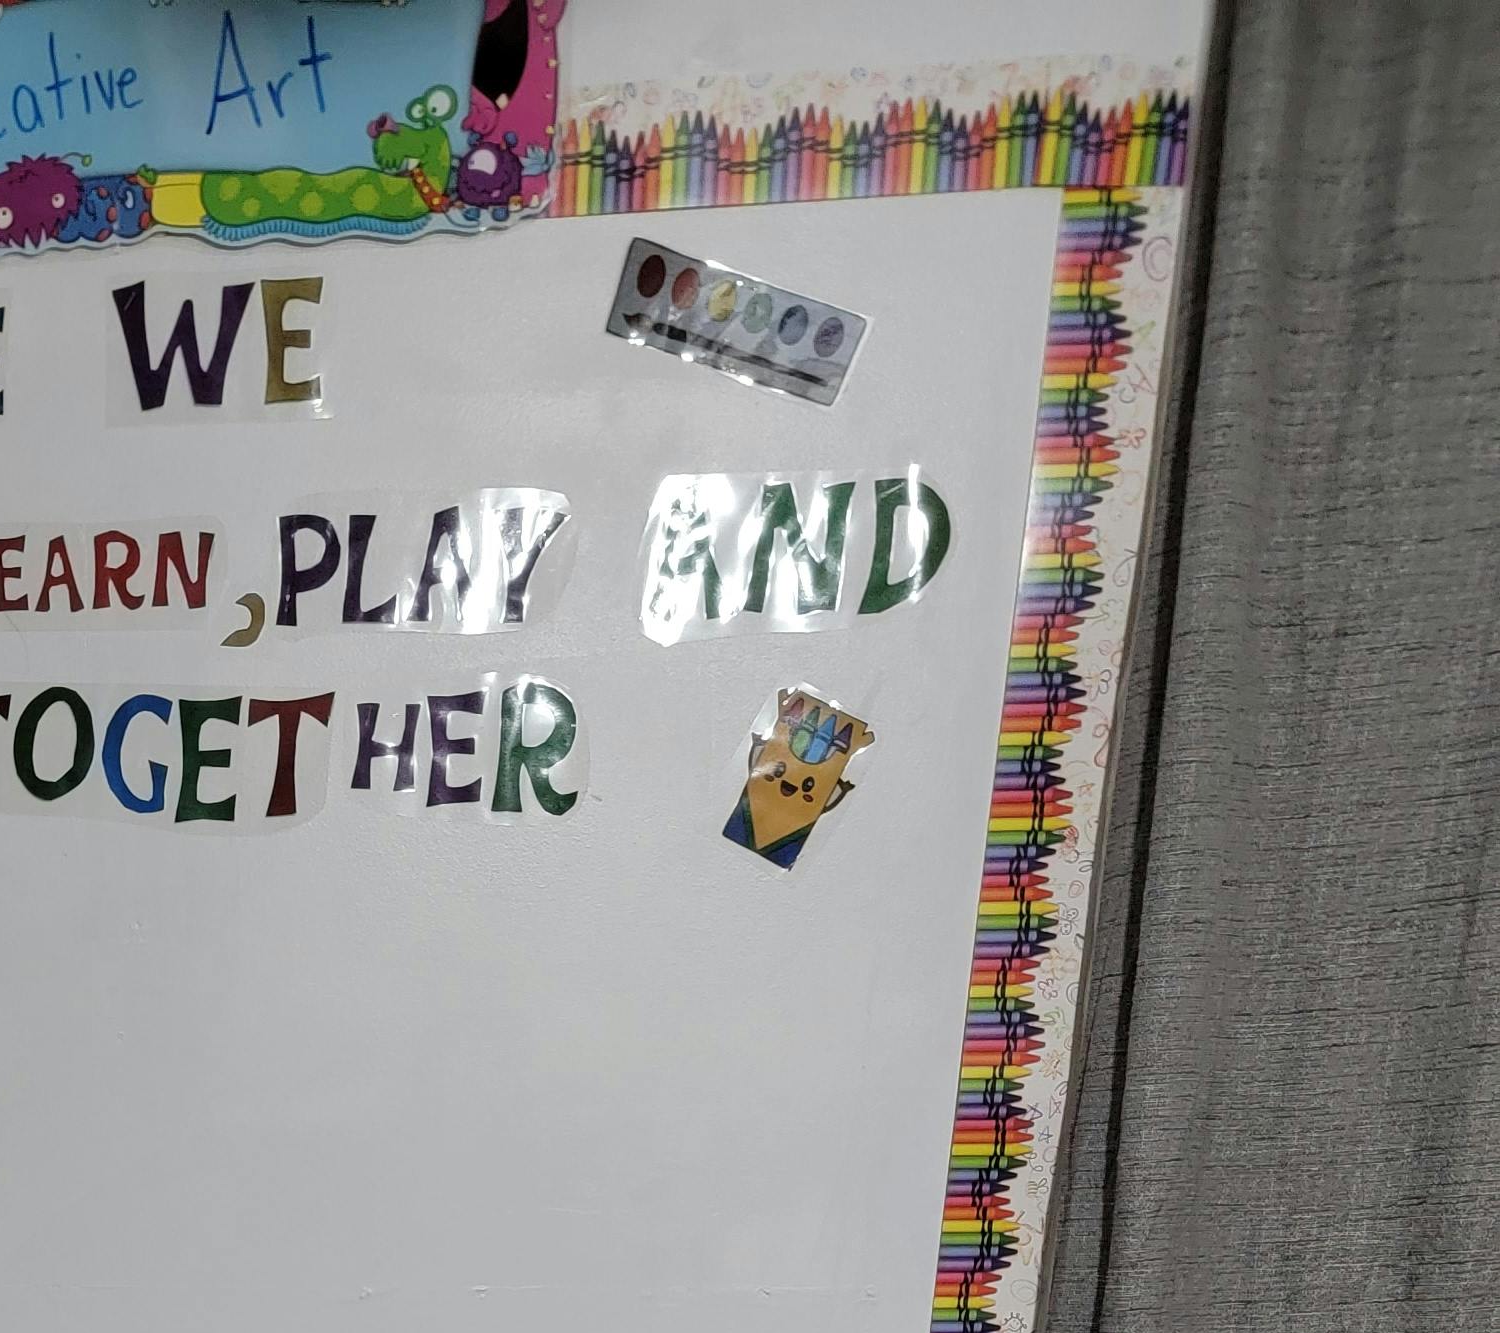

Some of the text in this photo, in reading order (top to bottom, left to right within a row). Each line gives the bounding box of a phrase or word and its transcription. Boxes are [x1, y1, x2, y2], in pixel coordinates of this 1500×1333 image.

[206, 9, 332, 134] Art
[113, 276, 324, 411] WE
[276, 507, 570, 626] PLAY
[650, 477, 951, 620] AND
